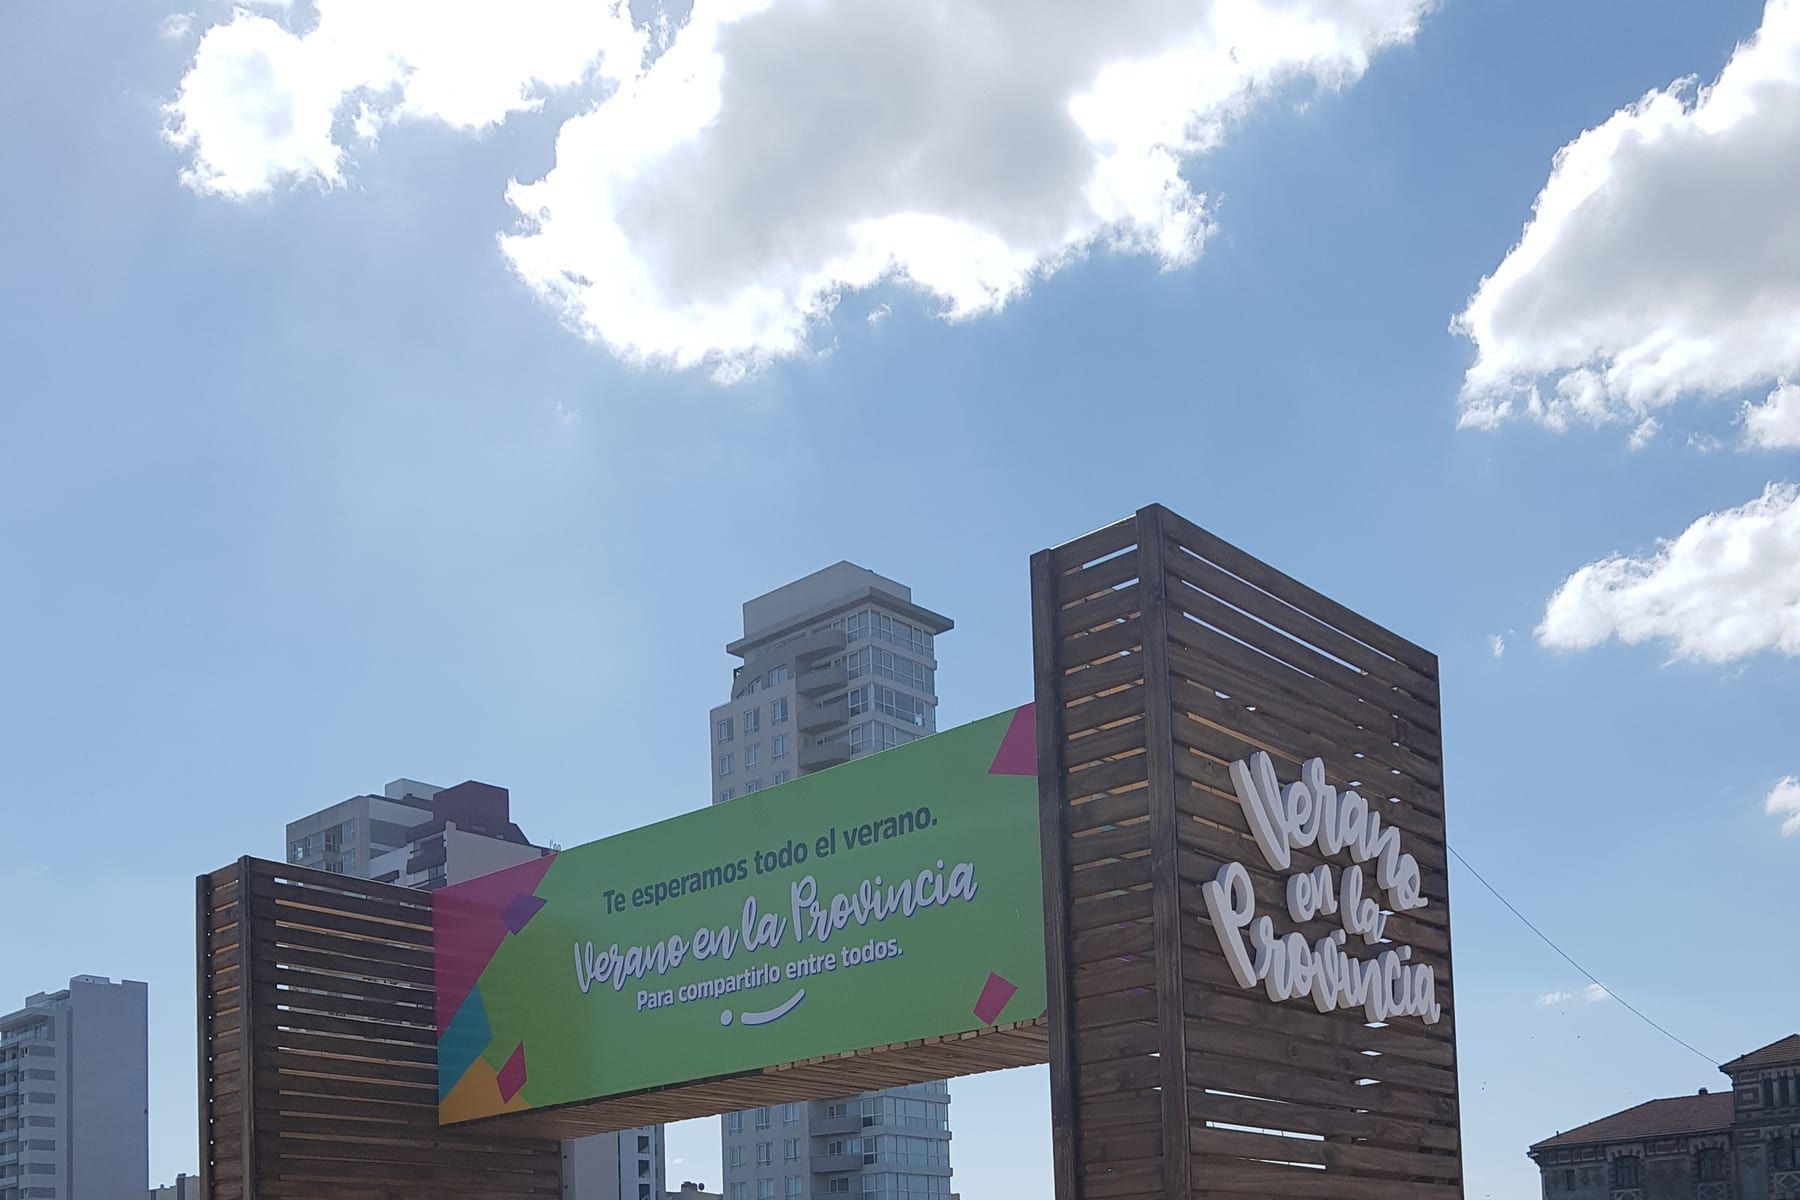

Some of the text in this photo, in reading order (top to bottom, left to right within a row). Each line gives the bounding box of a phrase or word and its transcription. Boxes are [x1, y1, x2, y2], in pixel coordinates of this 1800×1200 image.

[603, 806, 938, 915] Te esperamos todo el verano.
[1229, 751, 1428, 911] Verano
[574, 858, 979, 994] Verano en la Provincia
[1202, 861, 1440, 1024] Provincia
[1287, 864, 1387, 945] en la
[637, 937, 904, 1012] Para compartirlo entre todos.
